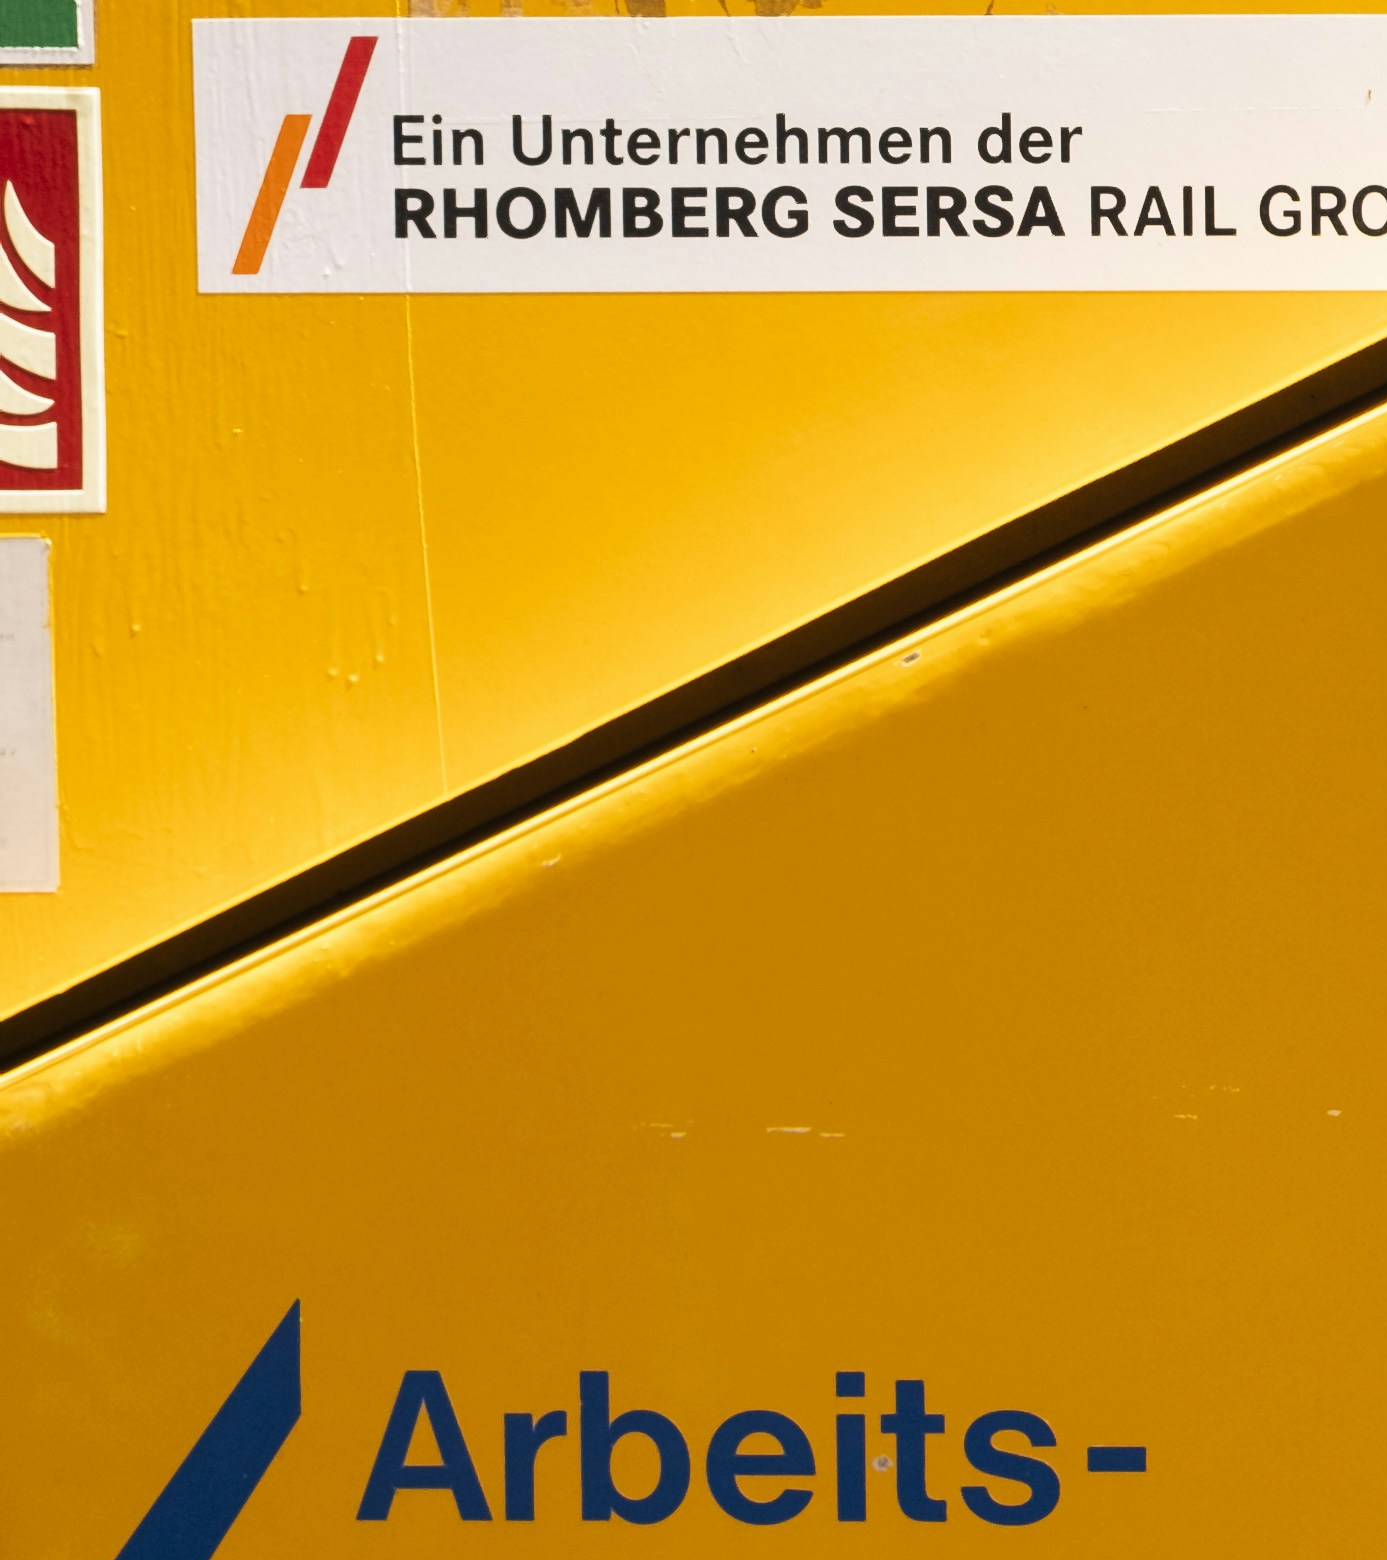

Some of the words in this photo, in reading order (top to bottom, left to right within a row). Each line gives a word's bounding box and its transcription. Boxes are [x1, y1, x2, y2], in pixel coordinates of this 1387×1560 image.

[394, 114, 484, 166] Ein
[512, 112, 952, 166] Unternehmen
[977, 112, 1083, 165] der
[394, 185, 810, 240] RHOMBERG
[832, 184, 1066, 238] SERSA
[1090, 184, 1237, 238] RAIL
[356, 1369, 1147, 1526] Arbeits-
